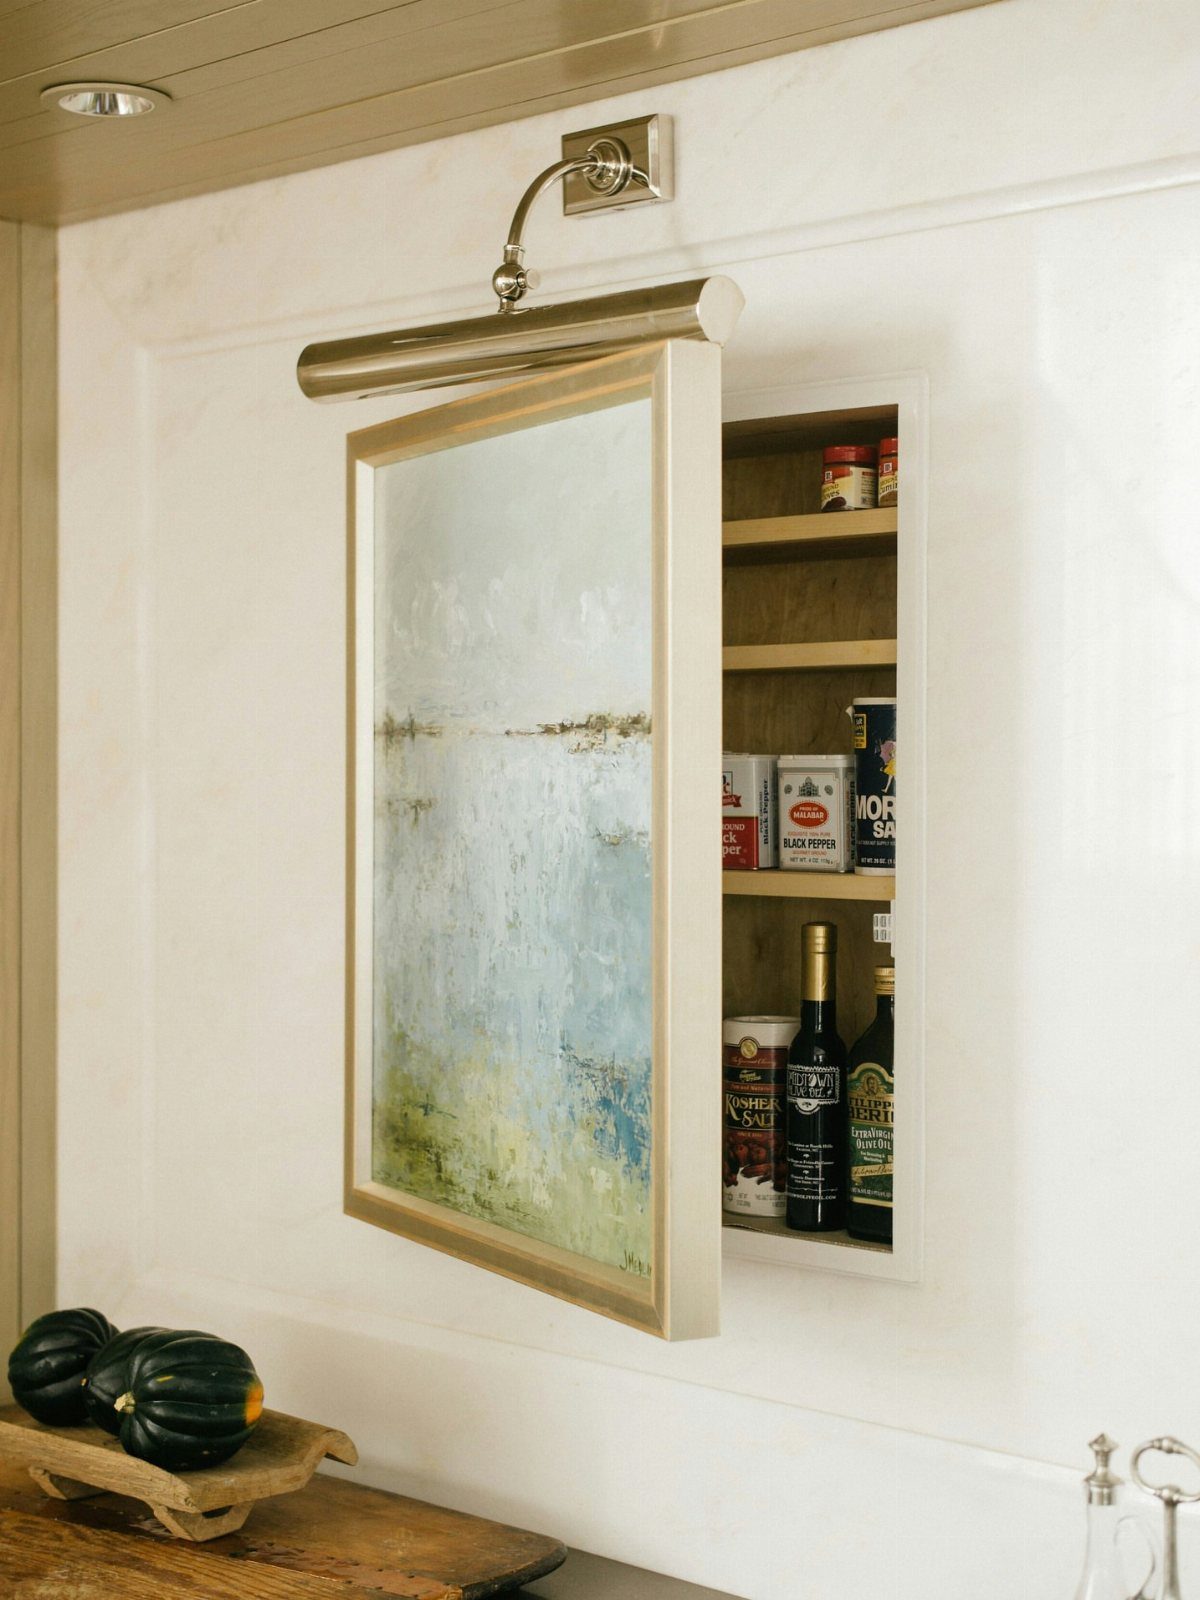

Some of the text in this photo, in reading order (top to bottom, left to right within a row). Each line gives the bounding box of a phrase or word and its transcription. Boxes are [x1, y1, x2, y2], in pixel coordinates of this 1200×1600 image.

[856, 795, 896, 820] MOR
[722, 823, 745, 831] OUND
[873, 820, 896, 838] SA
[722, 845, 742, 857] per
[783, 838, 836, 850] BLACK PEPPER
[725, 1094, 783, 1120] KOSHER
[849, 1098, 894, 1109] FILIPP
[741, 1110, 778, 1128] SALT
[849, 1106, 894, 1123] BERI
[856, 1138, 892, 1150] OLIVE OIL
